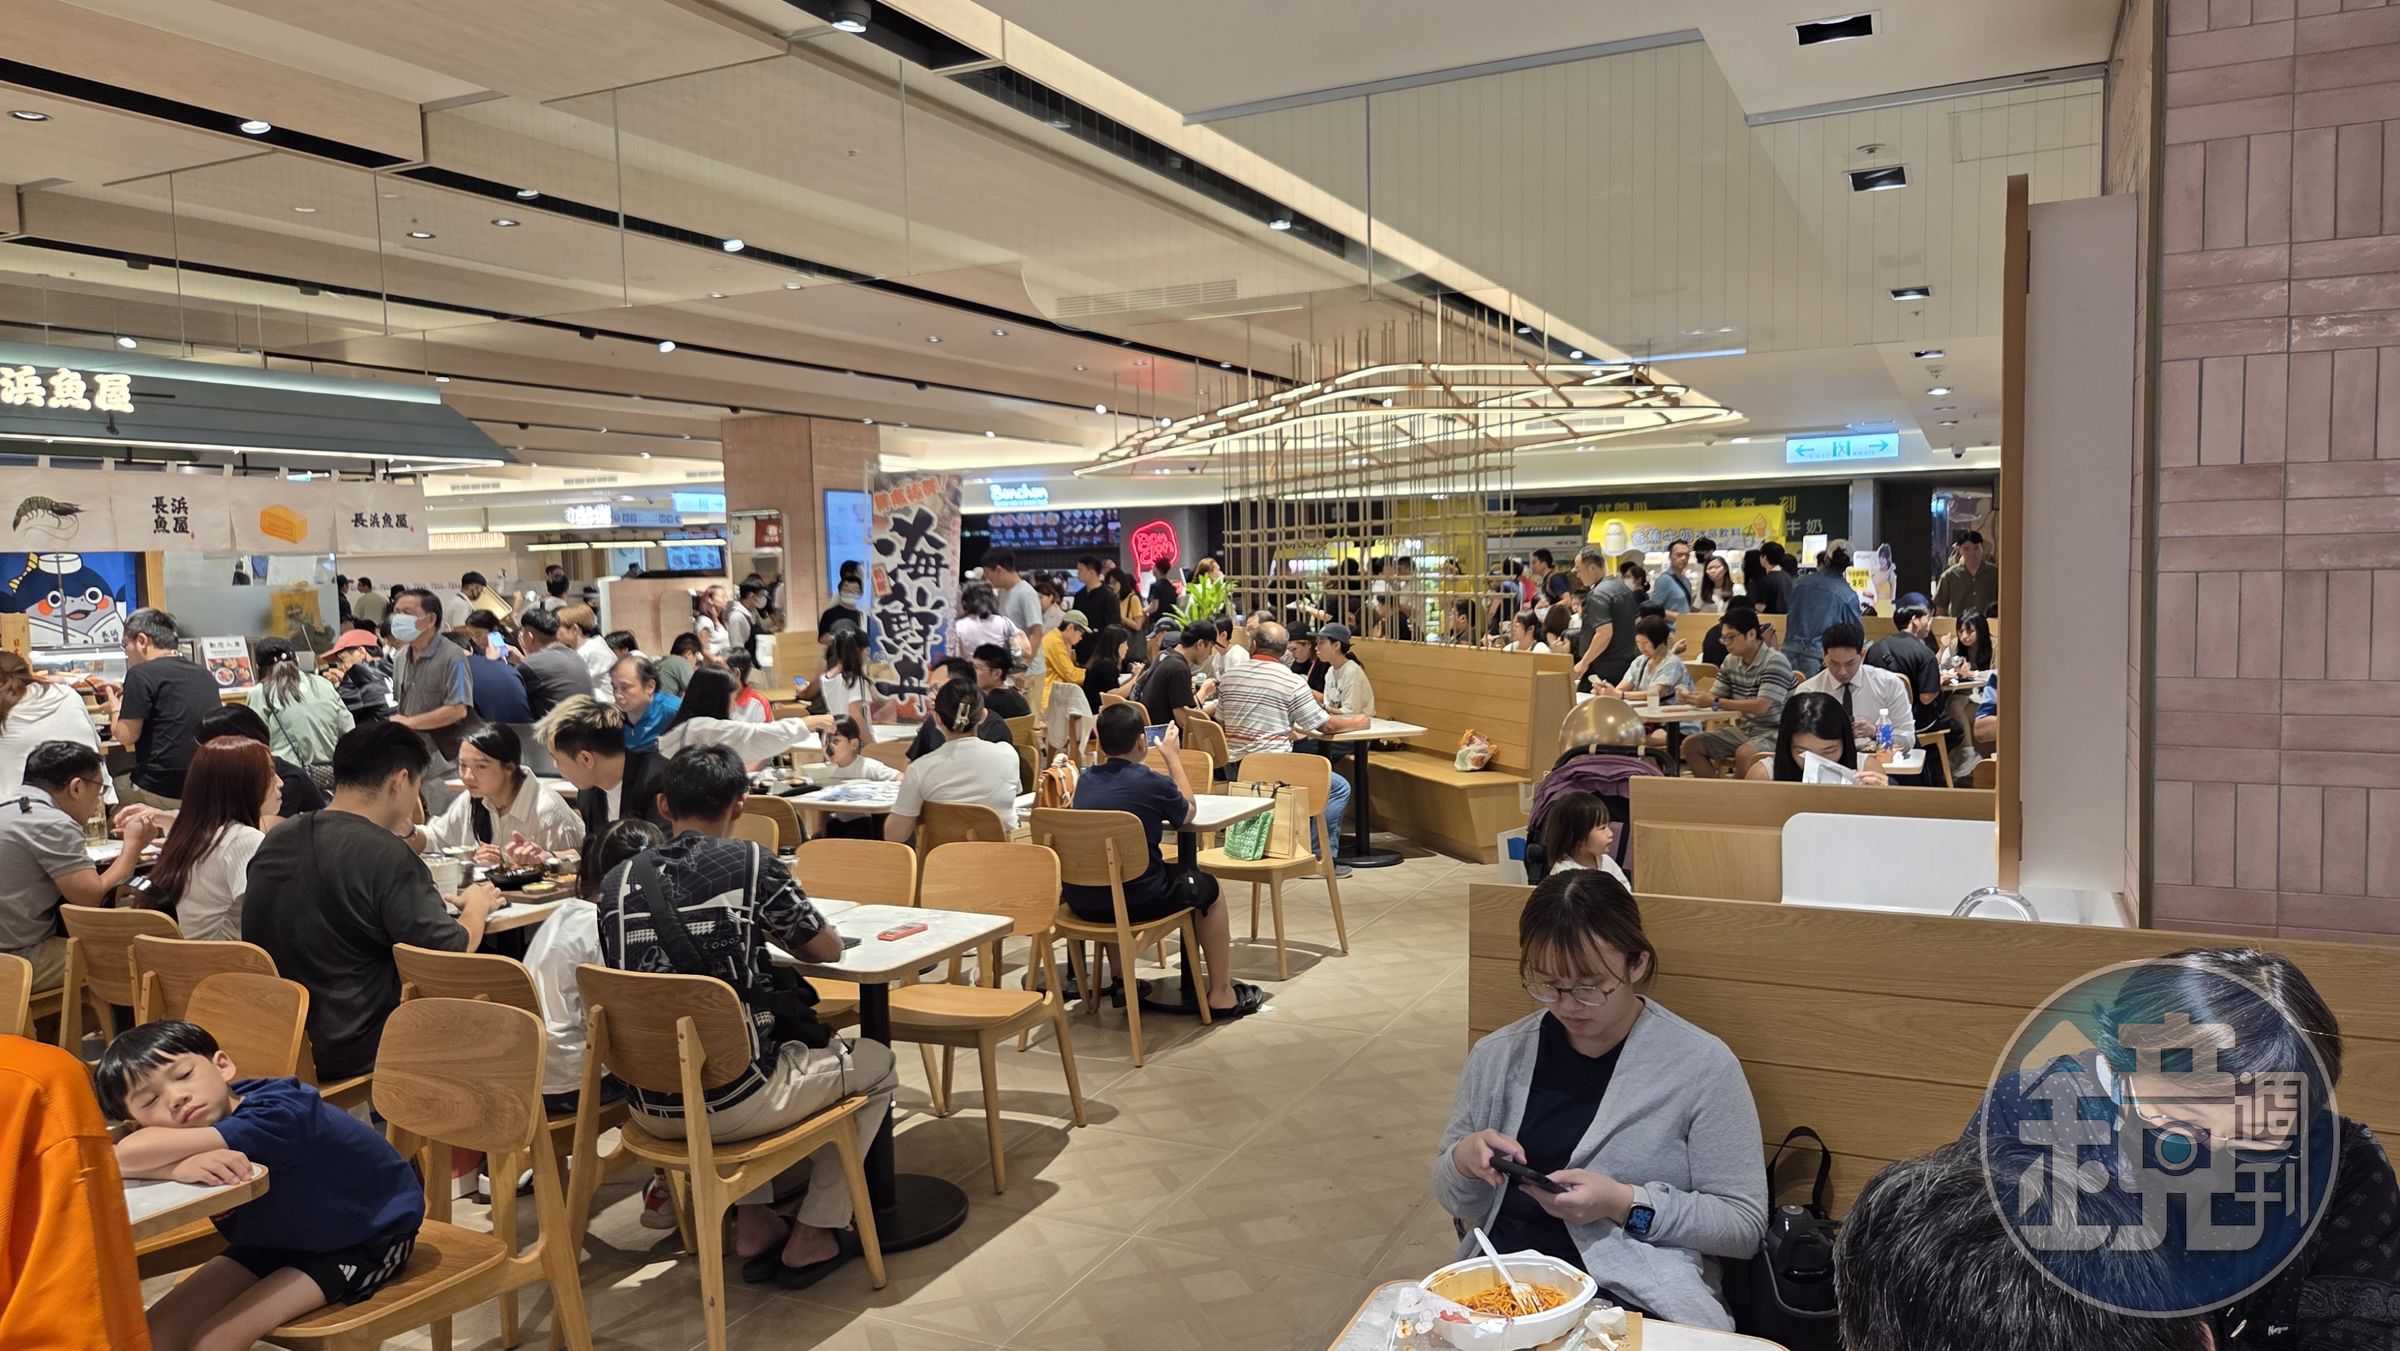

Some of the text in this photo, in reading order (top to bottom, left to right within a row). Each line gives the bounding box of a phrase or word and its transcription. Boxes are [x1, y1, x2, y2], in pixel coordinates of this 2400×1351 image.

[152, 496, 188, 515] 長浜
[153, 514, 190, 534] 魚屋
[350, 512, 409, 528] 長浜魚屋
